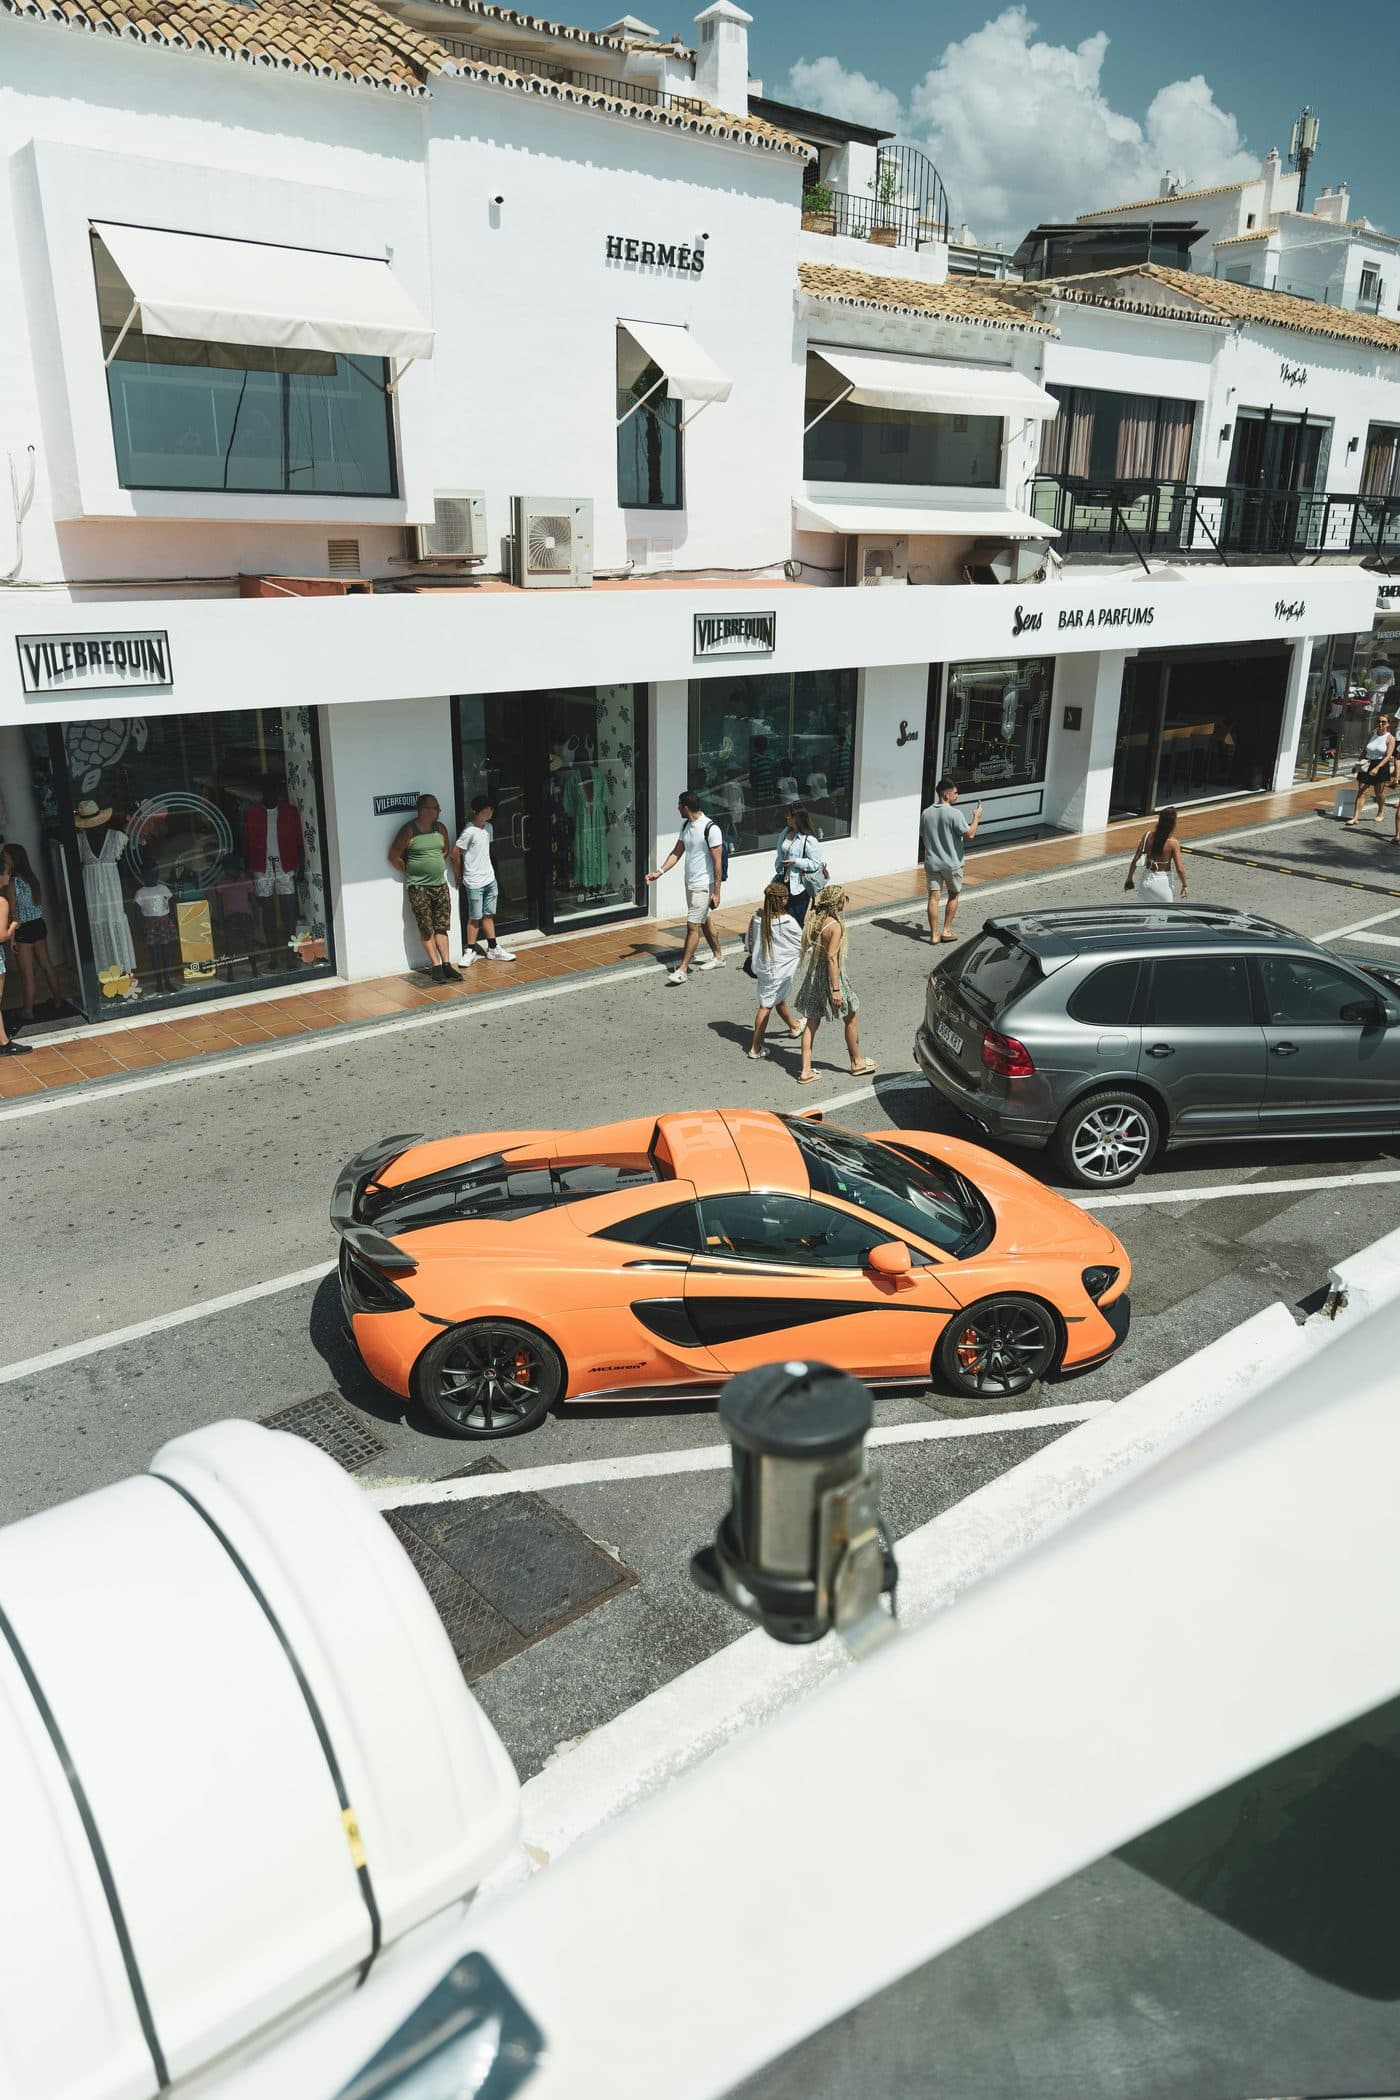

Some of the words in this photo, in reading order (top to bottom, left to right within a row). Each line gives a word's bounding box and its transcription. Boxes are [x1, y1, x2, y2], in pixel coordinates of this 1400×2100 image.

[697, 616, 773, 651] VILEBREQUIN
[1012, 605, 1043, 636] Sens
[1058, 609, 1084, 628] BAR
[1086, 609, 1095, 627] A
[1098, 606, 1155, 626] PARFUMS
[24, 639, 166, 688] VILEBREQUIN
[376, 794, 418, 813] VILEBREQUIN
[588, 1363, 643, 1373] McLaren
